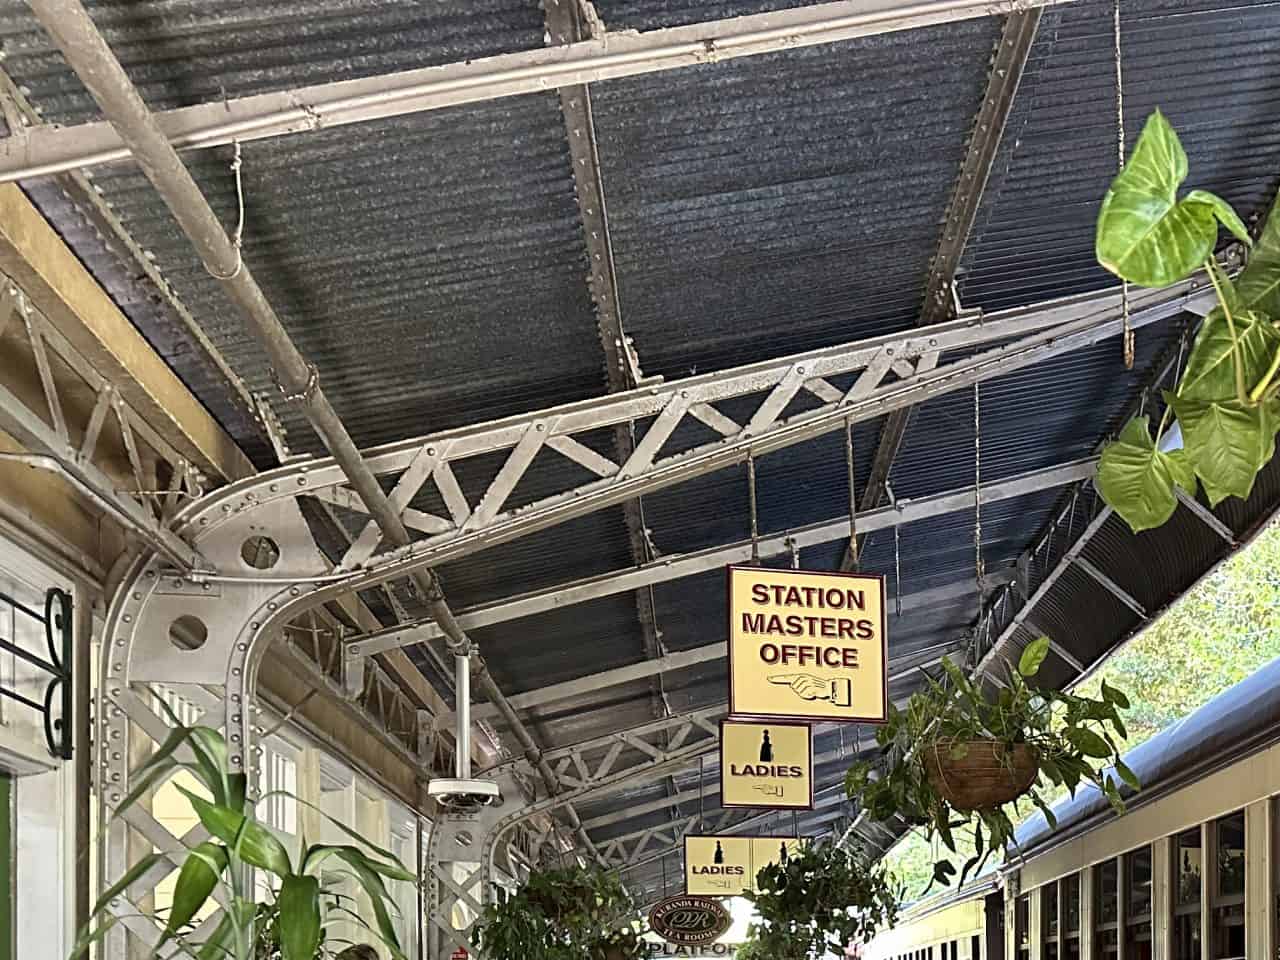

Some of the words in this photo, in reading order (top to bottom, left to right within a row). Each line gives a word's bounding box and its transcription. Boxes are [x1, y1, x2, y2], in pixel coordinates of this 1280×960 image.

[751, 583, 866, 610] STATION
[741, 612, 875, 640] MASTERS
[759, 643, 860, 669] OFFICE
[730, 763, 803, 779] LADIES
[692, 866, 745, 875] LADIES
[656, 900, 692, 918] KURANDA
